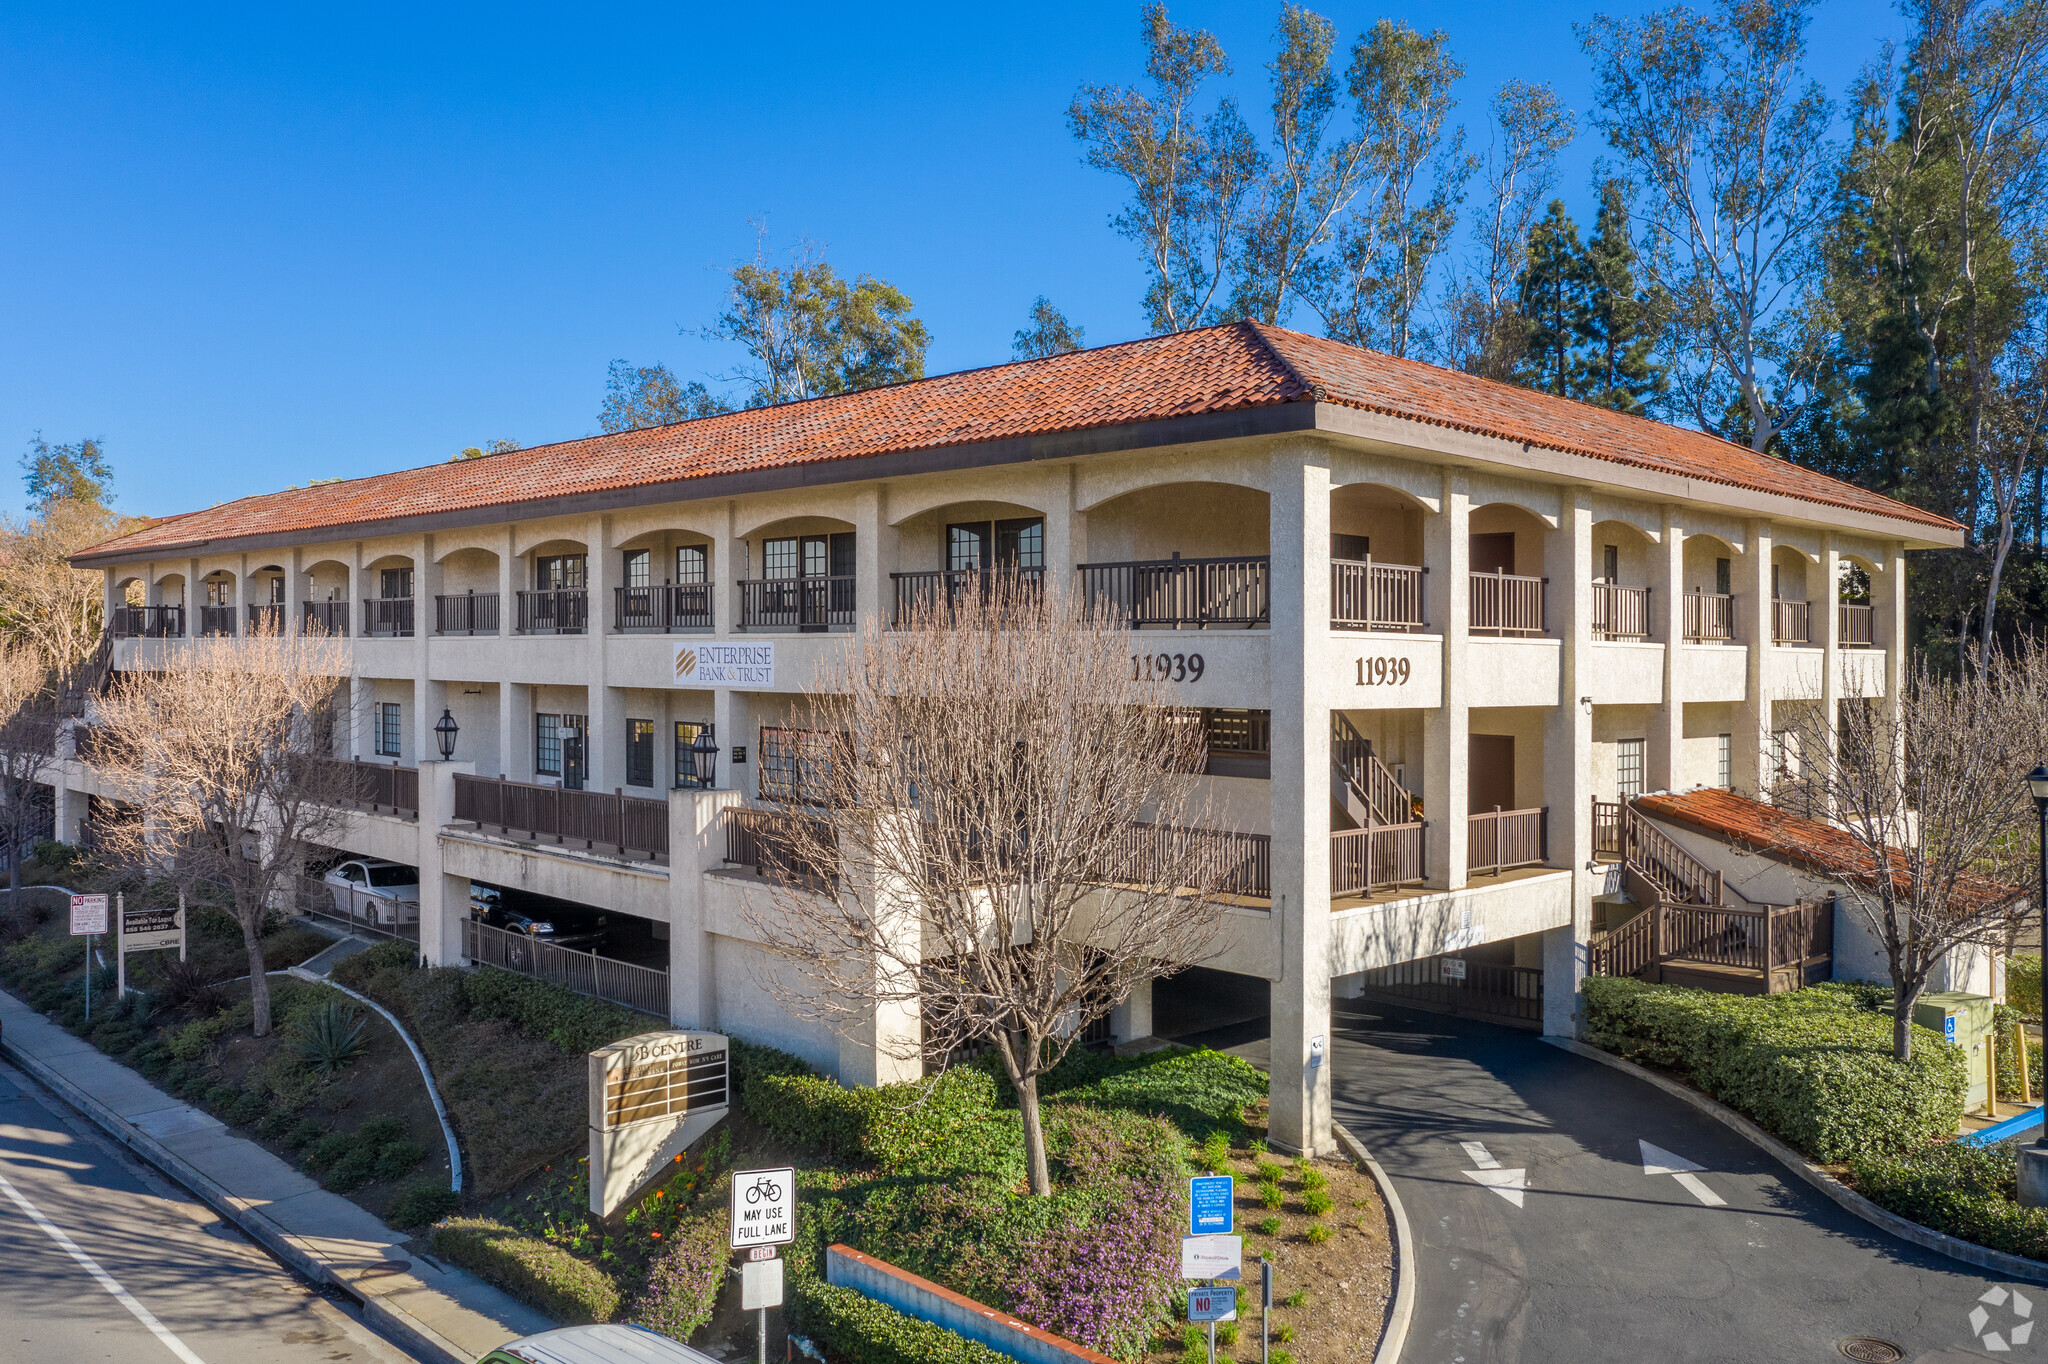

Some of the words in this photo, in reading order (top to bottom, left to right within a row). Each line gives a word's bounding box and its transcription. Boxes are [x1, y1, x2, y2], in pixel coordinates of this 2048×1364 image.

[699, 647, 771, 664] ENTERPRISE
[699, 666, 726, 681] BANK
[727, 666, 736, 681] &
[737, 667, 772, 682] TRUST
[1131, 653, 1205, 683] 11939
[1355, 656, 1411, 686] 11939
[73, 896, 83, 905] NO
[126, 917, 148, 926] Available
[149, 916, 157, 924] For
[651, 1038, 703, 1058] CENTRE
[744, 1208, 762, 1222] MAY
[765, 1206, 783, 1220] USE
[738, 1226, 760, 1239] FULL
[764, 1222, 787, 1236] LANE
[753, 1247, 773, 1259] BEGIN
[1196, 1297, 1210, 1311] NO
